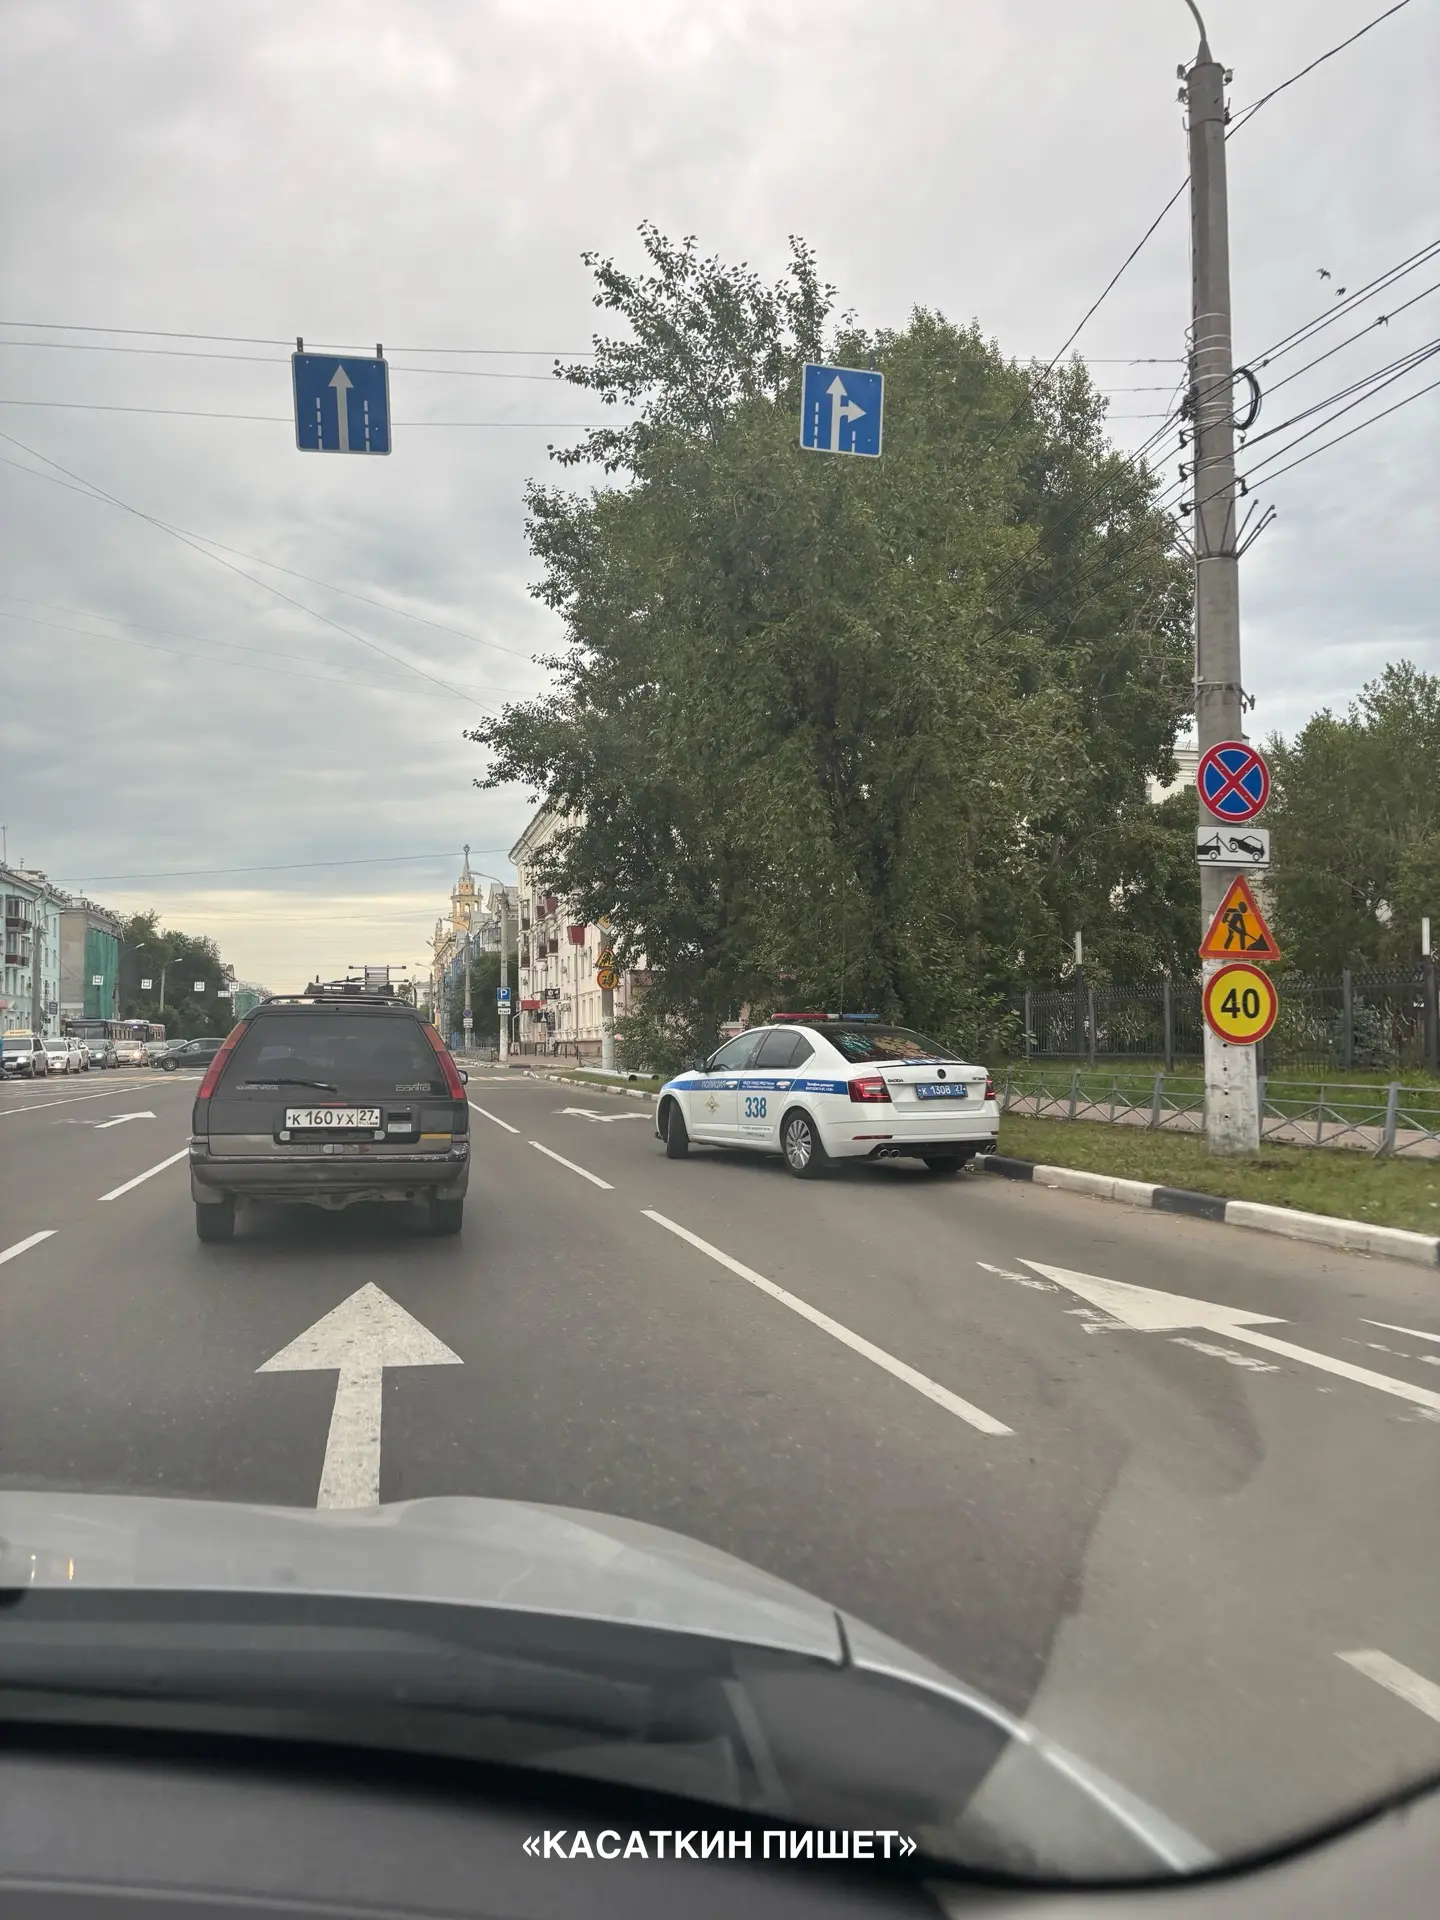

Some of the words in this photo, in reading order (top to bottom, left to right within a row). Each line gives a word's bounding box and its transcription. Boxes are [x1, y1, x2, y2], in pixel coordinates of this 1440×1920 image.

[1220, 988, 1260, 1019] 40
[359, 1109, 375, 1121] 27
[744, 1097, 767, 1119] 338
